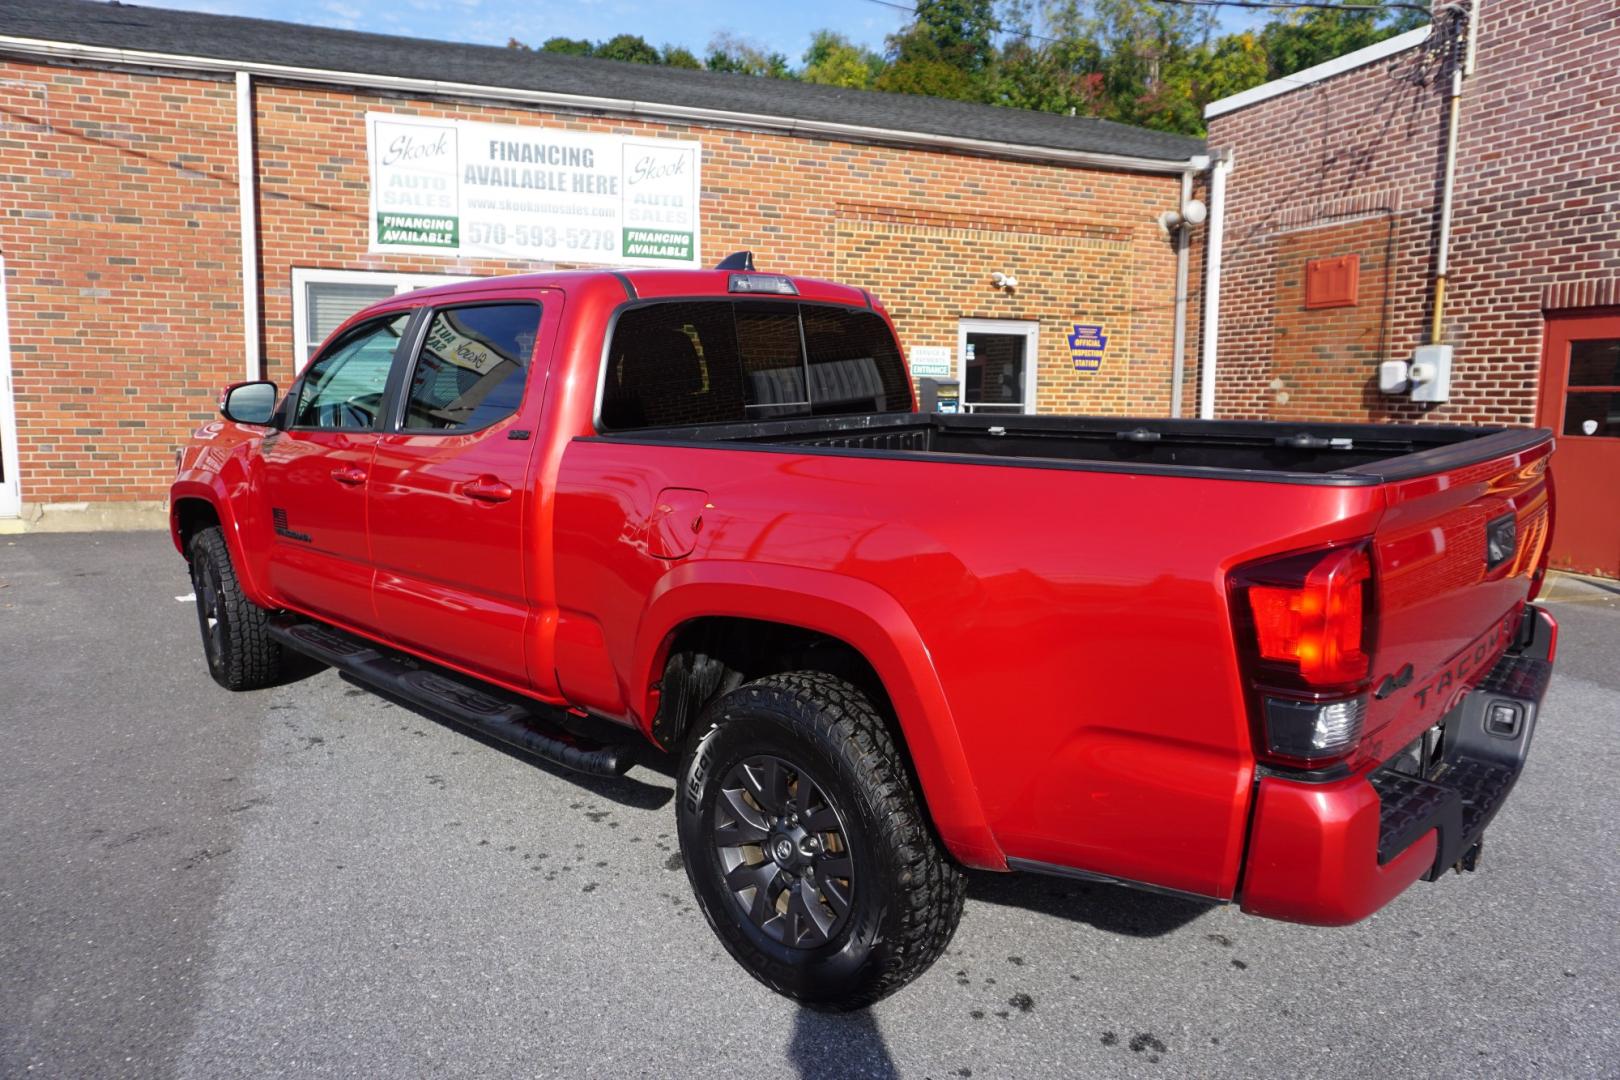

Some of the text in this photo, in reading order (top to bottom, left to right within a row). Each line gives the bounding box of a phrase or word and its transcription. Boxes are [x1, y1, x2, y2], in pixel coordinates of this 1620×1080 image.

[382, 131, 447, 166] Skook
[489, 140, 595, 168] FINANCING
[628, 153, 686, 185] Skook
[388, 173, 447, 192] AUTO
[464, 164, 619, 195] AVAILABLE HERE
[383, 191, 452, 209] SALES
[467, 197, 616, 218] www.skookautosales.com
[633, 192, 685, 208] AUTO
[383, 215, 454, 231] FINANCING
[628, 208, 688, 225] SALES
[383, 229, 453, 244] AVAILABLE
[468, 221, 616, 252] 570-593-5278
[627, 231, 690, 246] FINANCING
[627, 244, 689, 257] AVAILABLE
[1074, 338, 1101, 347] OFFICIAL
[1072, 349, 1103, 357] INSPECTION
[913, 365, 947, 374] ENTRANCE
[1074, 359, 1099, 368] STATION
